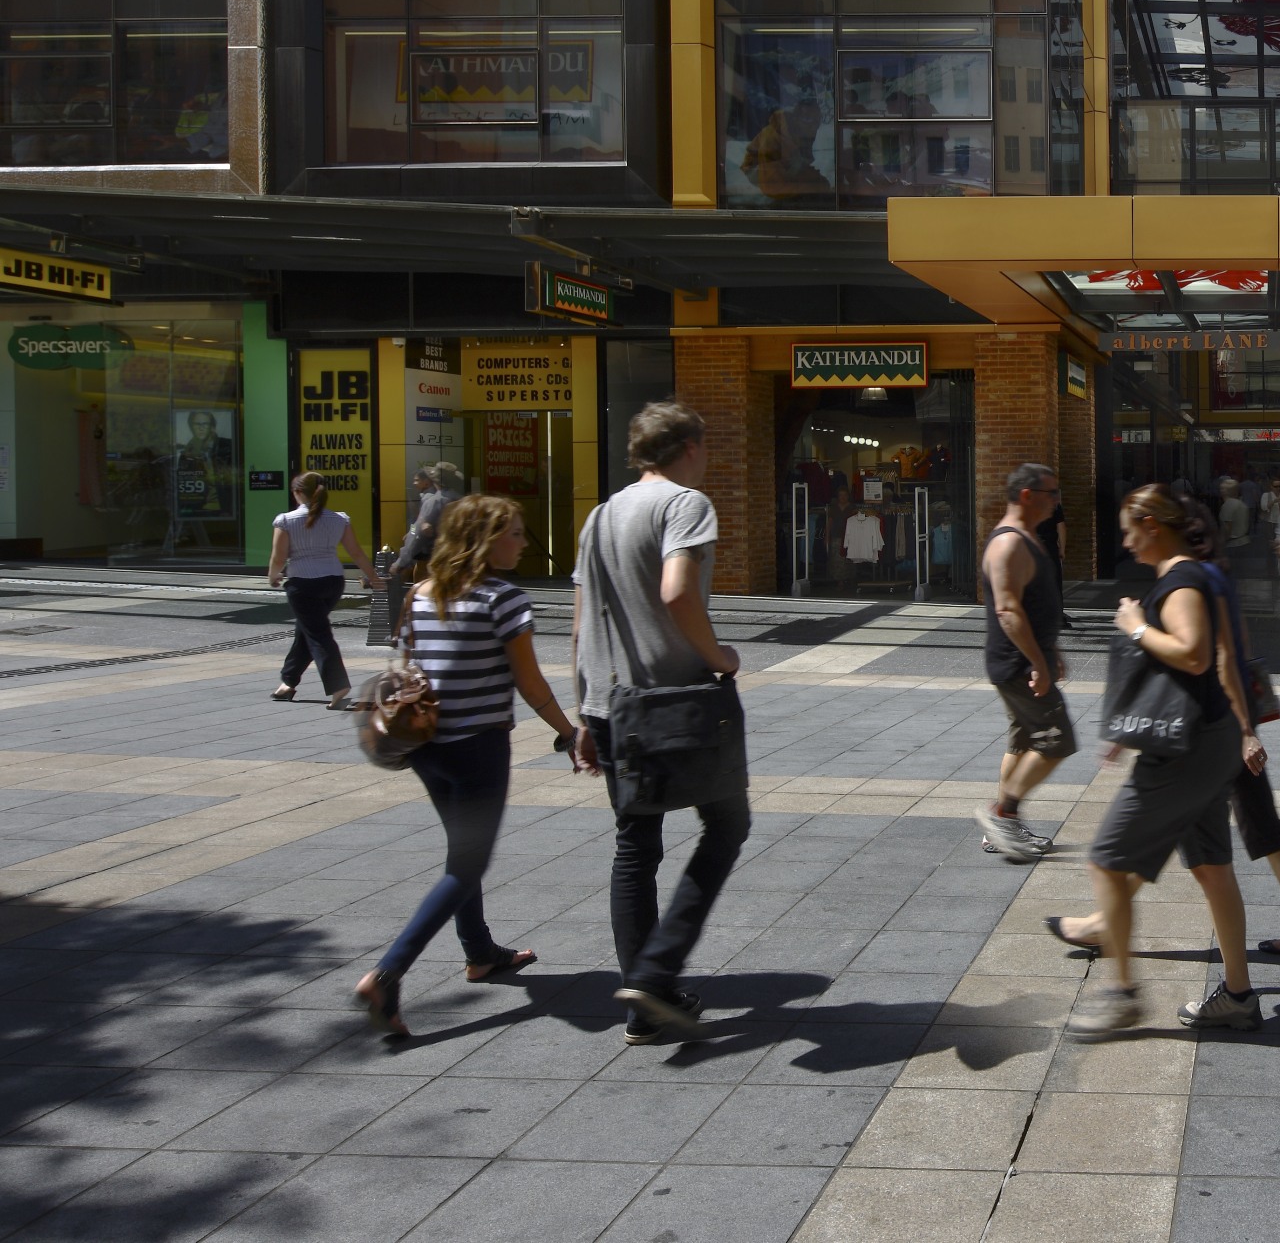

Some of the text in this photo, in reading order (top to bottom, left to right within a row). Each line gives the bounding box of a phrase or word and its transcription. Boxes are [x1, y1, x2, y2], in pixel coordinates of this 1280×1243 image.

[4, 259, 43, 281] JB
[557, 281, 606, 304] KATHMANDU
[18, 337, 110, 357] Specsavers
[1113, 332, 1268, 350] albert LANE
[425, 345, 443, 357] BEST
[420, 358, 448, 372] BRANDS
[477, 357, 572, 369] COMPUTERS G
[796, 350, 920, 369] KATHMANDU
[303, 371, 369, 400] JB
[477, 373, 569, 386] CAMERAS CDs
[418, 382, 450, 395] Canon
[310, 433, 363, 450] ALWAYS
[428, 434, 453, 444] PS3
[488, 427, 533, 448] PRICES
[306, 454, 367, 471] CHEAPEST
[488, 451, 534, 463] COMPUTERS
[488, 465, 525, 478] CAMERAS
[178, 480, 205, 493] $59
[318, 475, 358, 490] RICES
[1109, 714, 1184, 739] SUPRÉ
